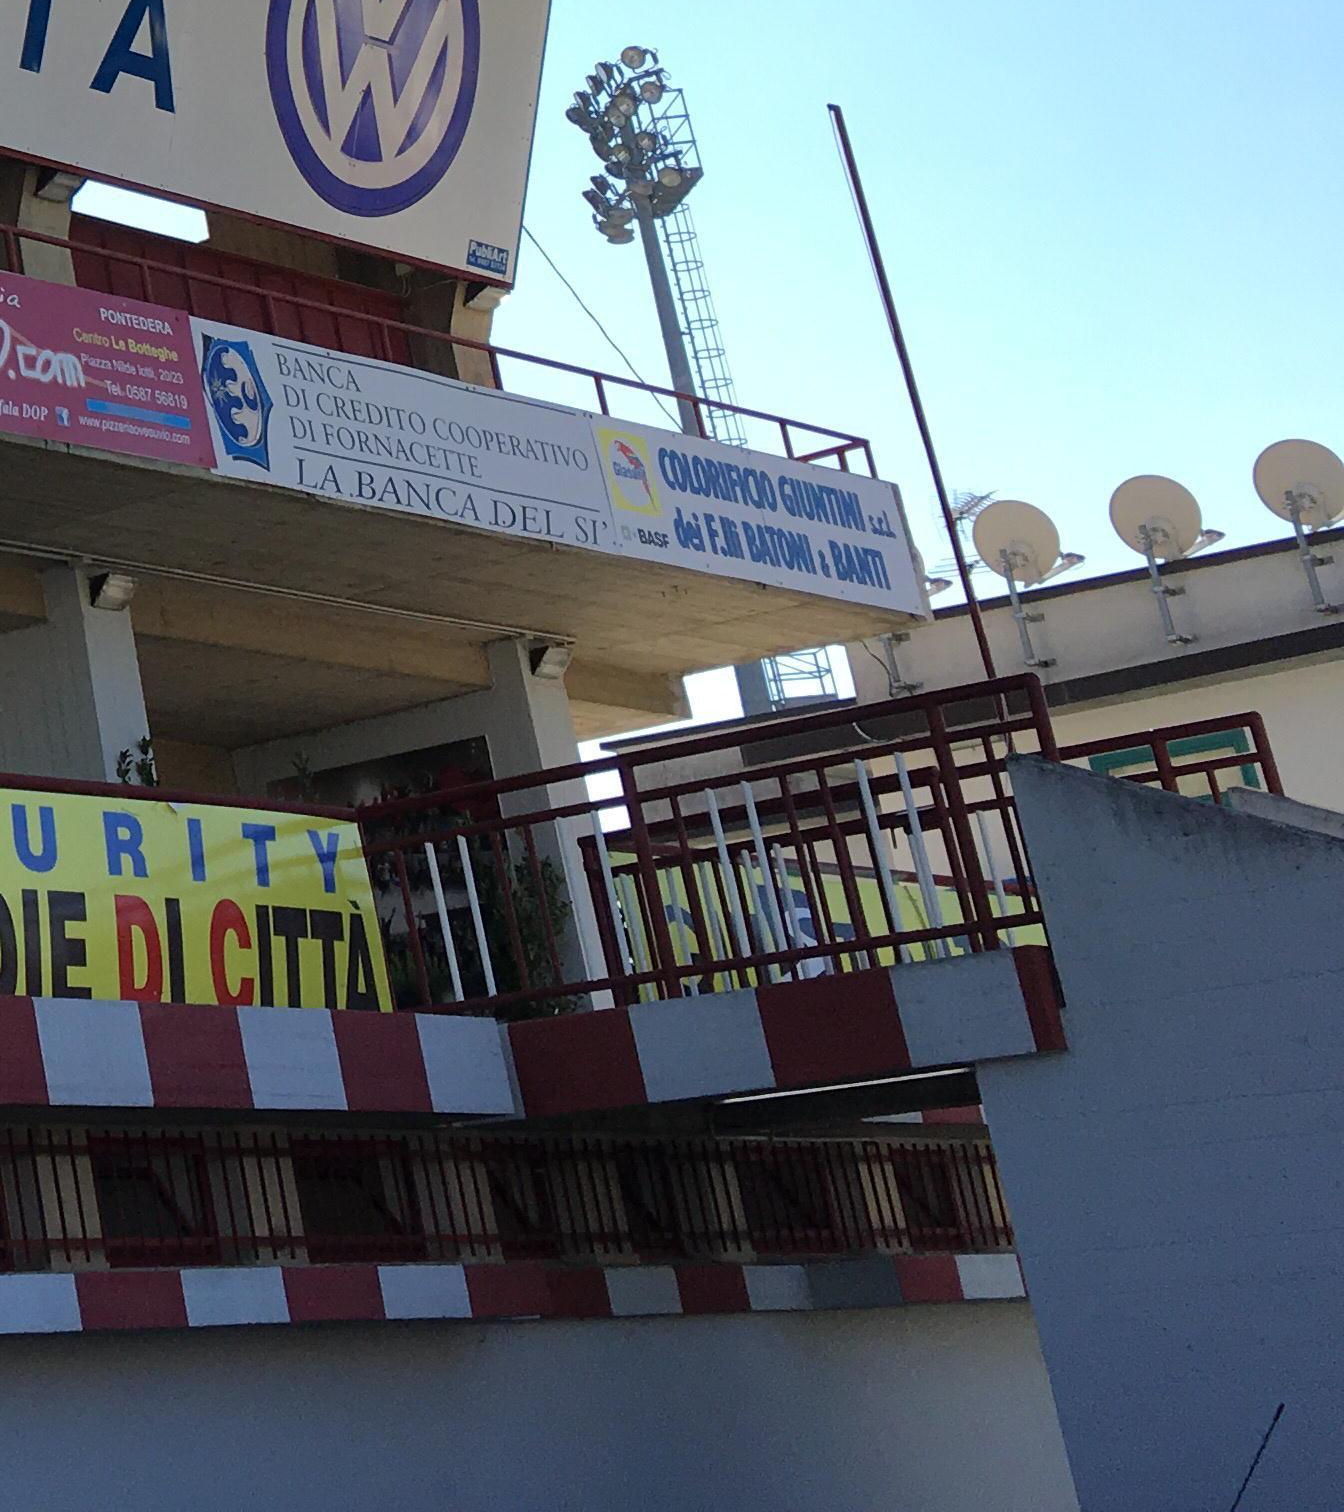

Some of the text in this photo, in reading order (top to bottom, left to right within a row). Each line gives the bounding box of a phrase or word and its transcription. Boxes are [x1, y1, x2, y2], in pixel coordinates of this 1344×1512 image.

[99, 307, 174, 336] PONTEDERA
[276, 352, 361, 393] BANCA
[22, 402, 49, 423] DOP
[282, 384, 589, 473] DI CREDITO COOPERATIVO
[289, 415, 483, 479] DI FORNACETTE
[295, 457, 344, 496] LA
[356, 469, 480, 523] BANCA
[489, 499, 565, 539] DEL
[657, 446, 778, 514] COLORIFICIO
[779, 474, 867, 534] GIUNTINI
[637, 527, 670, 550] BASF
[673, 507, 703, 551] dei
[743, 520, 818, 576] BATONI
[829, 539, 893, 591] BANTI
[117, 893, 184, 1004] DI
[209, 897, 381, 1013] CITTÀ
